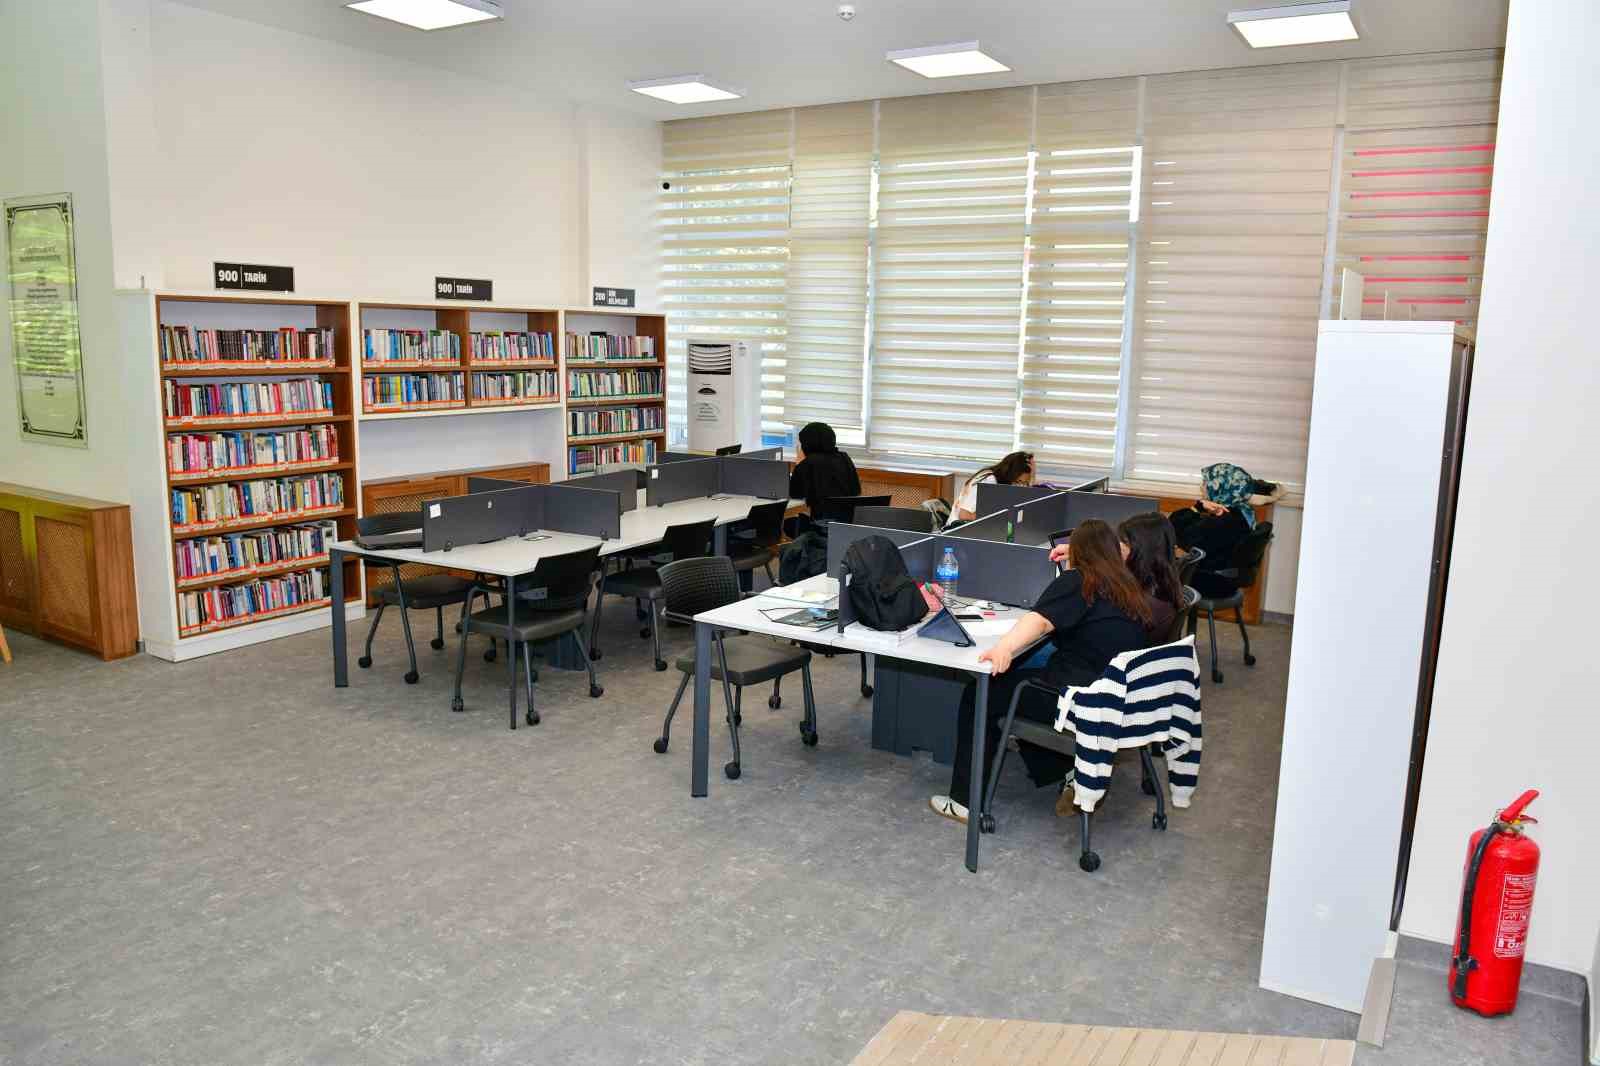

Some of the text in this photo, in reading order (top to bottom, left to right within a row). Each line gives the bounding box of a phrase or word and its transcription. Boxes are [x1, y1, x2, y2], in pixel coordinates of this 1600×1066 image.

[218, 270, 267, 283] 900 TARİH
[438, 283, 453, 293] 900
